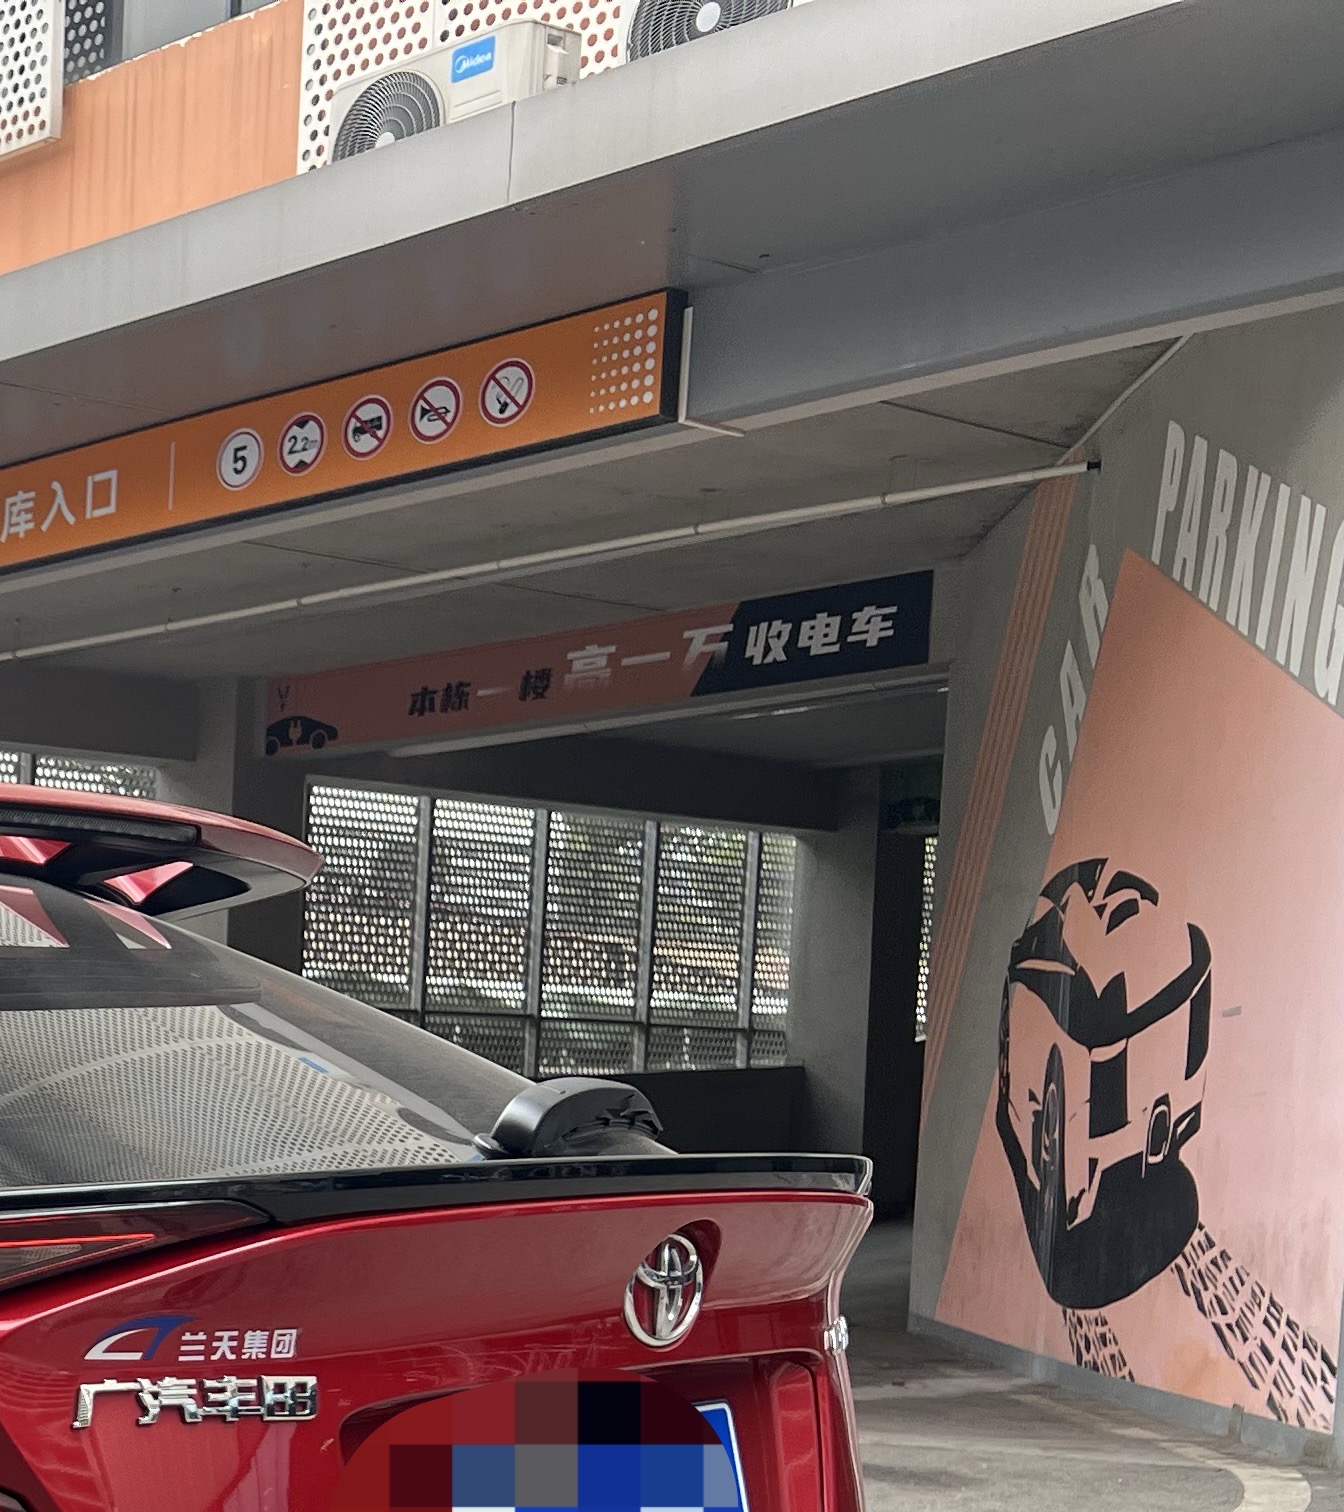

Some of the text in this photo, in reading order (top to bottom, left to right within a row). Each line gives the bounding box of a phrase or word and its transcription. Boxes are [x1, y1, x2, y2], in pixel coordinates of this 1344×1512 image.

[454, 51, 492, 74] Midea
[232, 445, 248, 475] 5
[1151, 419, 1344, 706] PARKING
[178, 1328, 299, 1362] 兰天集团
[72, 1375, 318, 1429] 广汽丰田
